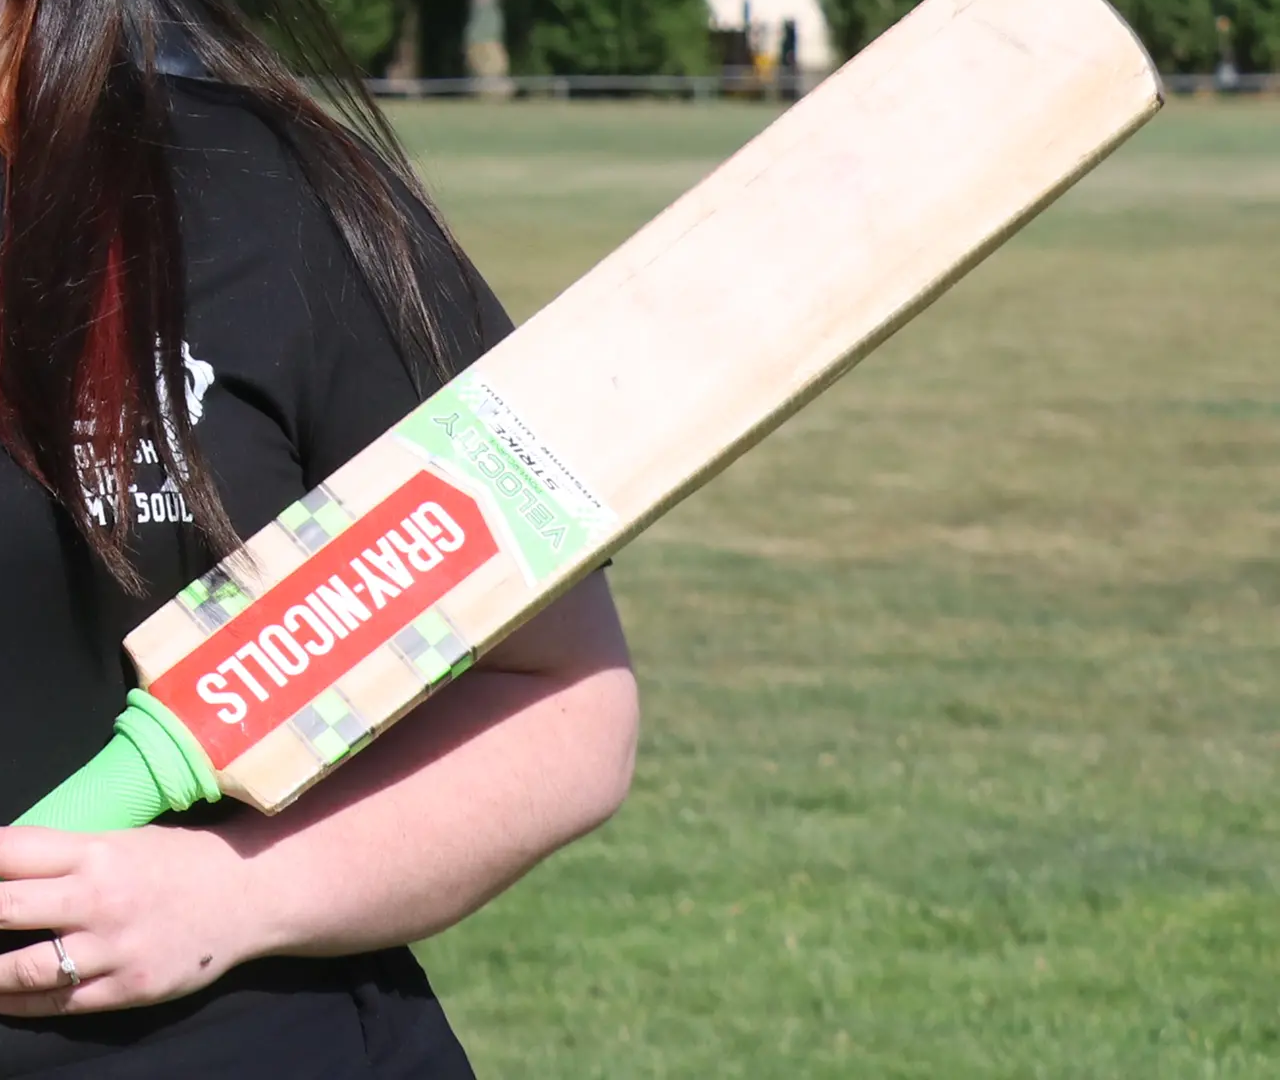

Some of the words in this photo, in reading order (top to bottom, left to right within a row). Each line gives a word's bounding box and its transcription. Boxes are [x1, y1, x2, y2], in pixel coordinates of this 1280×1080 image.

[133, 492, 194, 523] SOUL
[433, 412, 567, 549] VELOCITY
[489, 423, 560, 491] STRIKE
[195, 500, 466, 724] GRAY-NICOLLS
